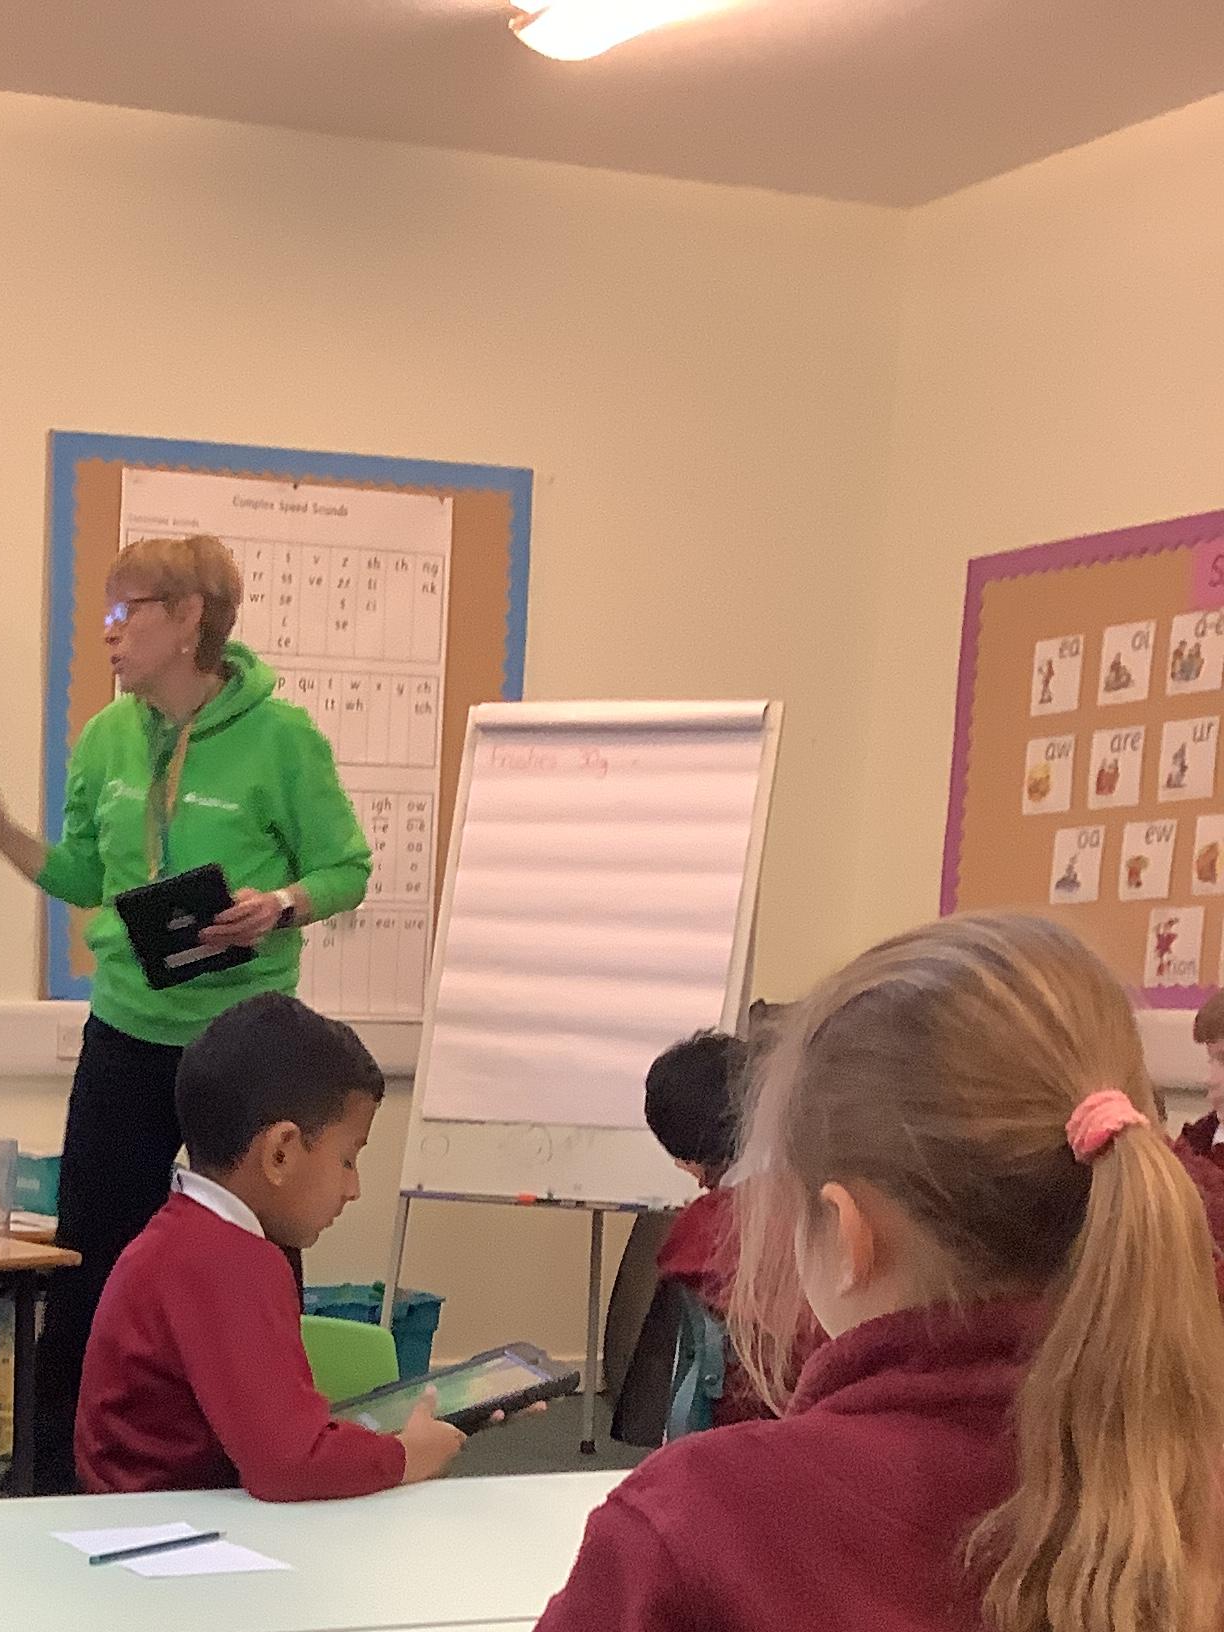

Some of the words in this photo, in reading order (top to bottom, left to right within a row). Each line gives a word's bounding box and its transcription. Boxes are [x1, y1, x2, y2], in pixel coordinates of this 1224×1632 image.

[232, 495, 274, 511] Complex
[279, 500, 308, 514] Speed
[312, 502, 348, 516] Sounds
[395, 557, 408, 572] th
[309, 576, 323, 586] ve
[1059, 637, 1081, 659] ea
[298, 677, 315, 693] qu
[345, 699, 364, 712] wh
[1045, 741, 1071, 761] aw
[1110, 731, 1142, 753] are
[1192, 720, 1214, 743] ur
[372, 797, 392, 815] igh
[407, 801, 426, 812] ow
[1077, 829, 1100, 849] oa
[1144, 823, 1174, 845] ew
